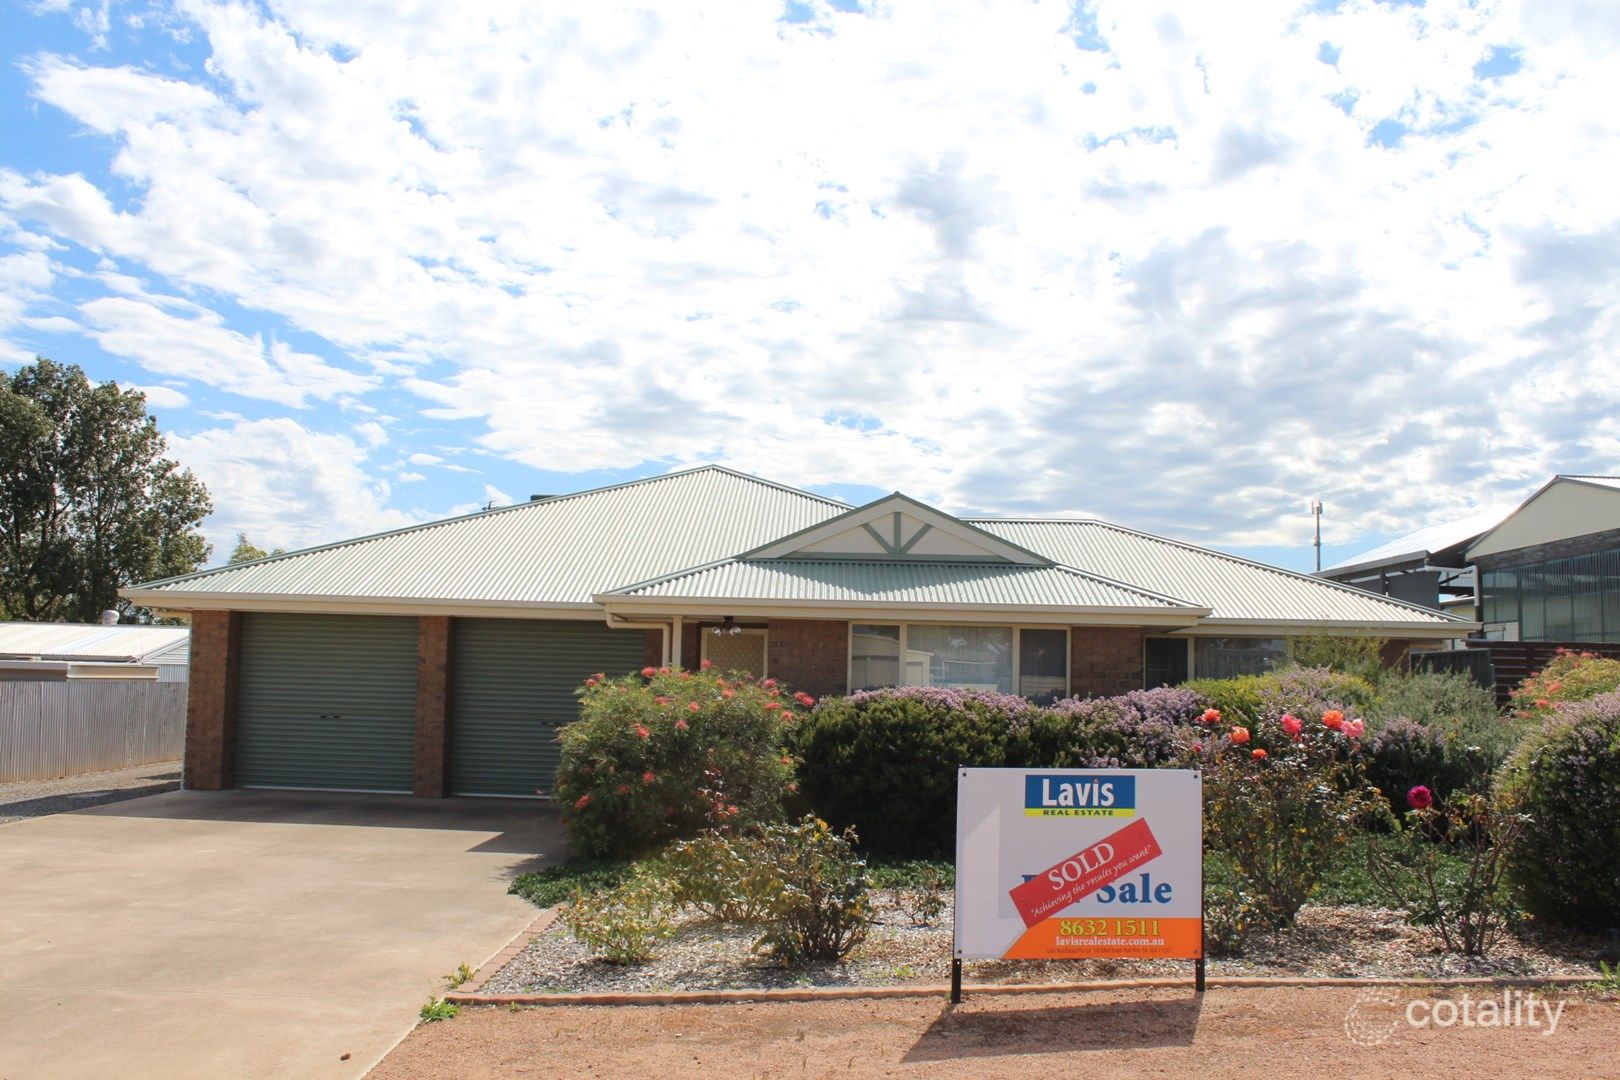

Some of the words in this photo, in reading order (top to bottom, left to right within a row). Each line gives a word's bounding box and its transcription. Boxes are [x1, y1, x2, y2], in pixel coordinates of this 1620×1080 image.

[1043, 778, 1115, 807] Lavis
[1048, 842, 1115, 890] SOLD
[1072, 884, 1086, 895] the
[1087, 868, 1113, 886] results
[1111, 861, 1128, 877] you
[1055, 936, 1165, 946] lavisrealestate.com.au
[1060, 920, 1109, 936] 8632
[1115, 920, 1160, 936] 1511
